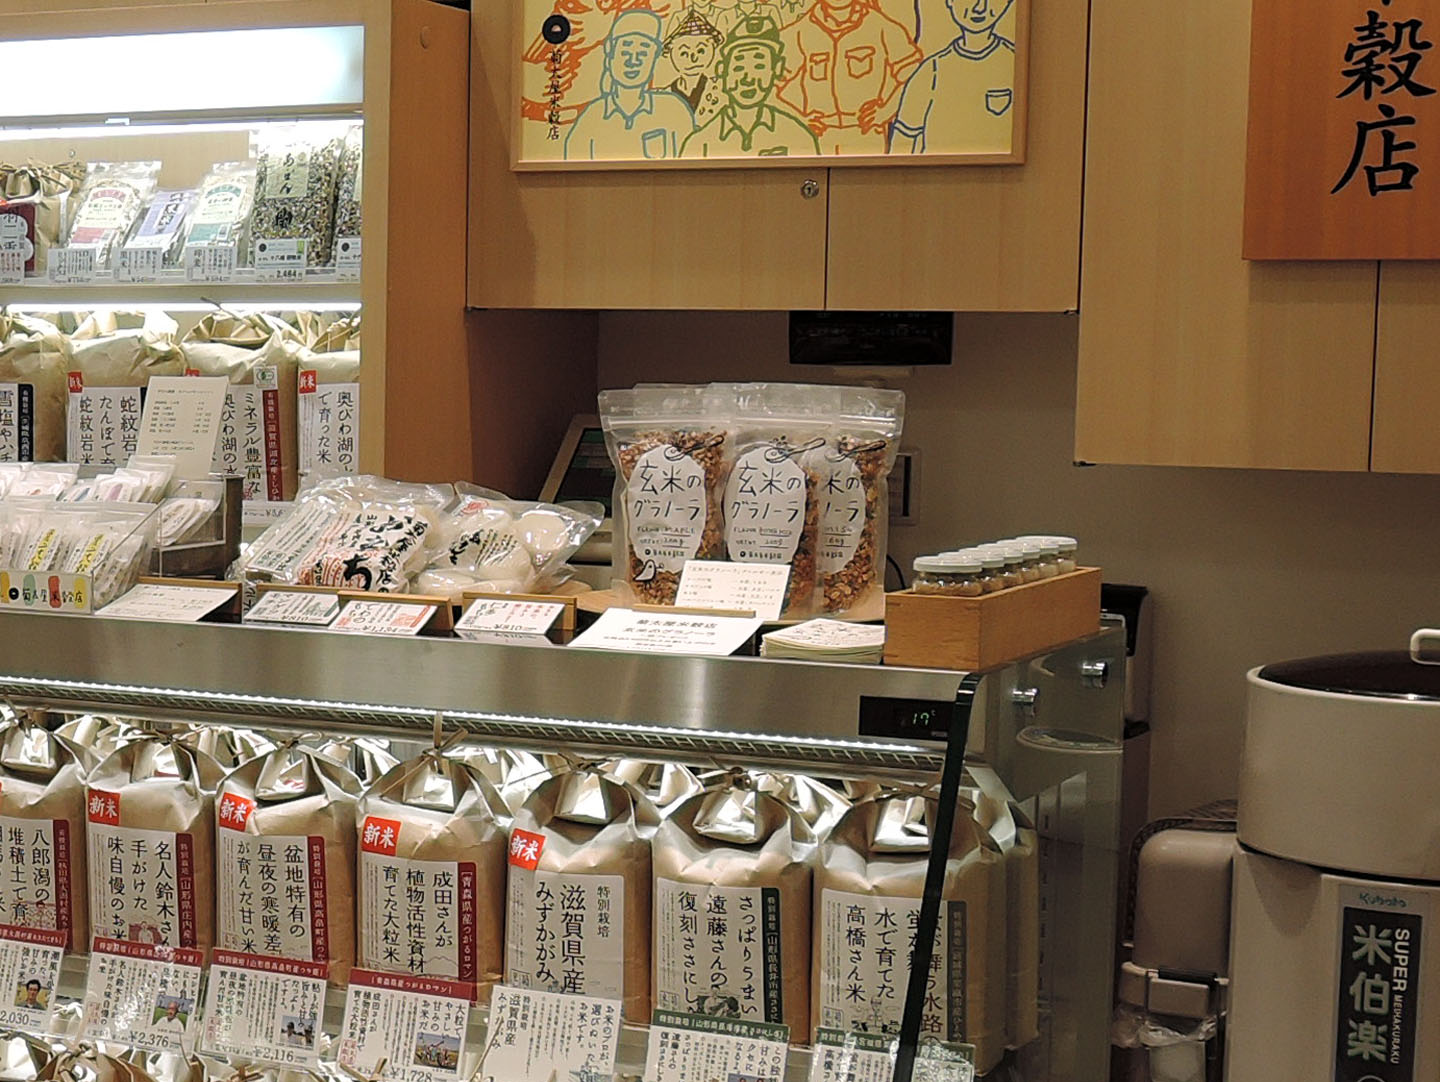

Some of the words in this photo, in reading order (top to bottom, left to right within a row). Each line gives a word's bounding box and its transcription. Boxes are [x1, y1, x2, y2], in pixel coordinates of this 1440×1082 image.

[1331, 0, 1437, 196] 穀店
[633, 499, 701, 522] グラノーラ
[639, 460, 702, 496] 玄米の
[731, 500, 799, 523] グラノーラ
[738, 461, 802, 497] 玄米の
[89, 796, 118, 818] 新米
[220, 801, 248, 824] 新米
[362, 824, 397, 849] 新米
[32, 829, 51, 902] 八郎潟の
[130, 839, 148, 911] 手がけた
[511, 836, 539, 861] 新米
[237, 840, 257, 953] が育んだ甘い米
[258, 844, 282, 954] 昼夜の寒暖差
[284, 844, 307, 938] 盆地特有の
[382, 865, 401, 964] 育てた大粒米
[406, 868, 427, 974] 植物活性資材
[432, 871, 454, 949] 成田さんが
[596, 885, 611, 938] 特別栽培
[535, 881, 556, 983] みずかがみ
[560, 884, 586, 996] 滋賀県産
[706, 894, 728, 987] 遠藤さんの
[737, 896, 758, 1016] さっぱりうまい
[846, 904, 866, 1003] 高橋さん米
[874, 908, 898, 1000] 水で育てた
[1392, 929, 1410, 992] SUPER
[1346, 923, 1394, 1064] 米伯楽
[130, 1031, 169, 1047] ¥2,376
[253, 1045, 294, 1062] ¥2,116
